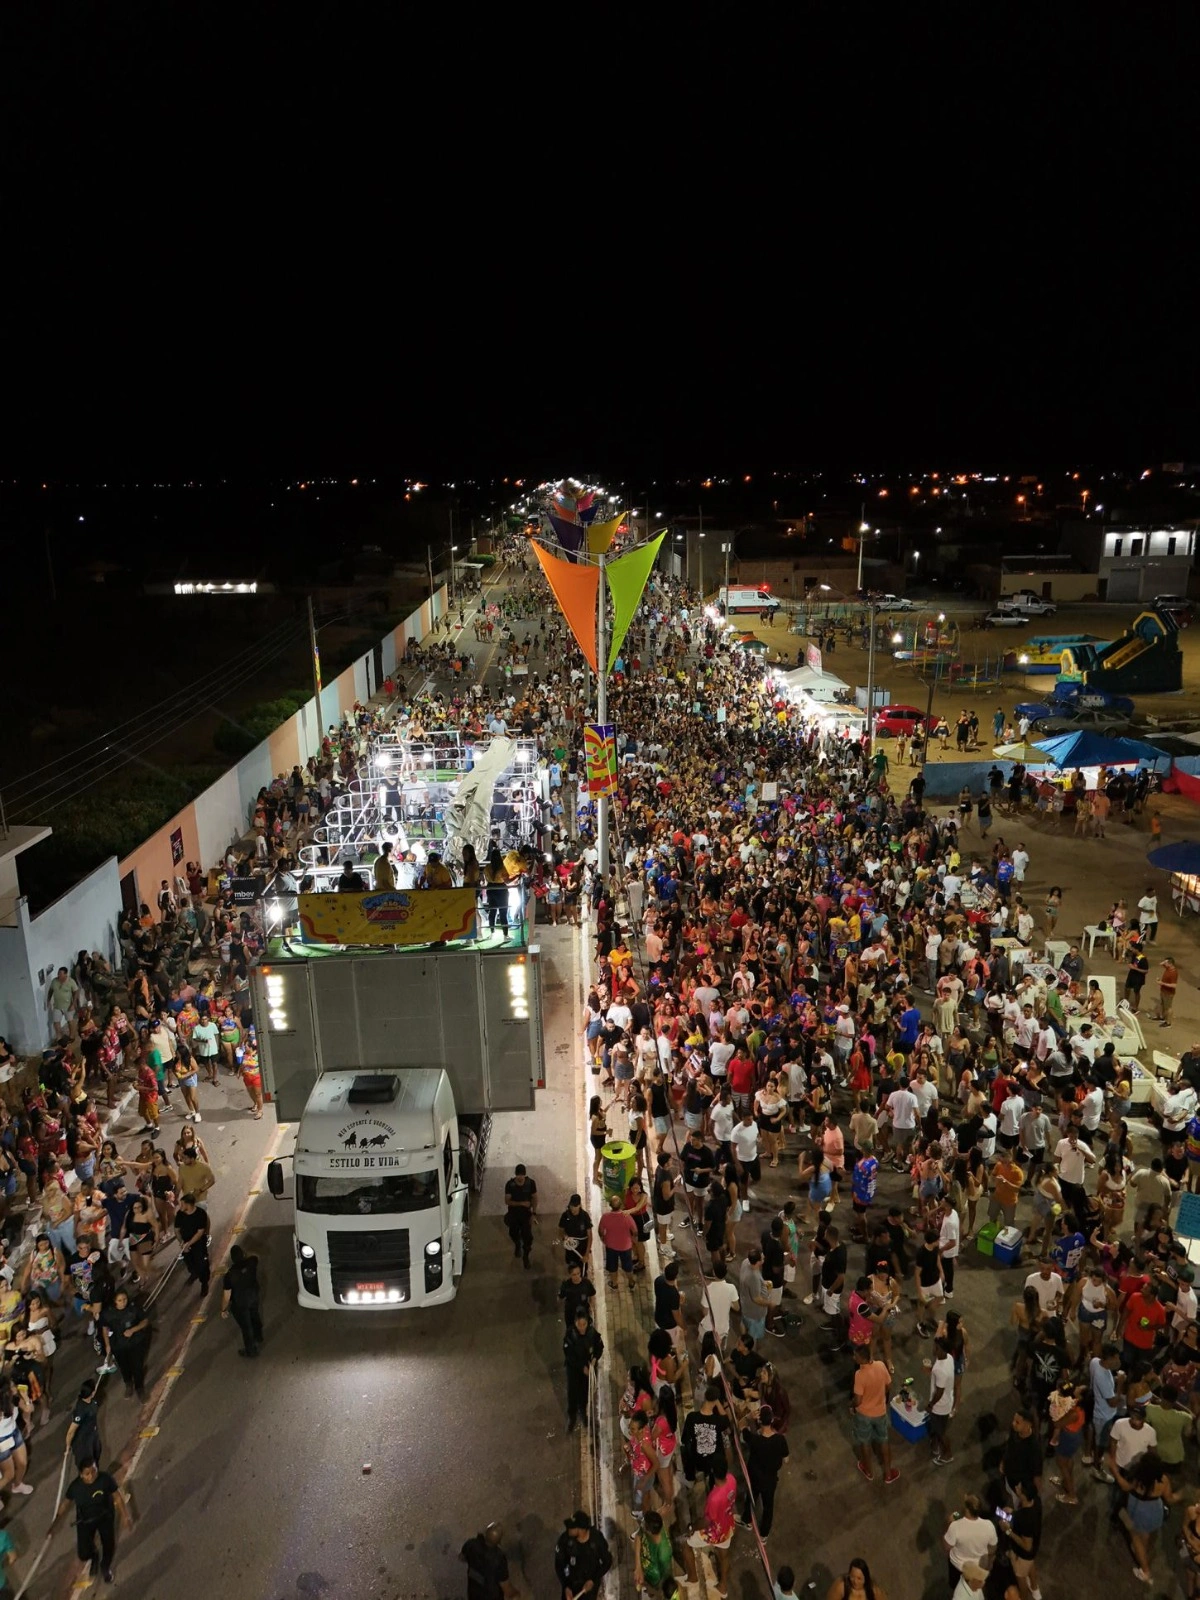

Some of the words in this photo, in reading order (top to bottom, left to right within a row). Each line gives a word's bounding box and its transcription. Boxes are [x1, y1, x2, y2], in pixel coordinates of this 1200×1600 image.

[330, 1158, 360, 1168] ESTILO
[364, 1157, 375, 1167] DE
[378, 1156, 400, 1167] VIDA
